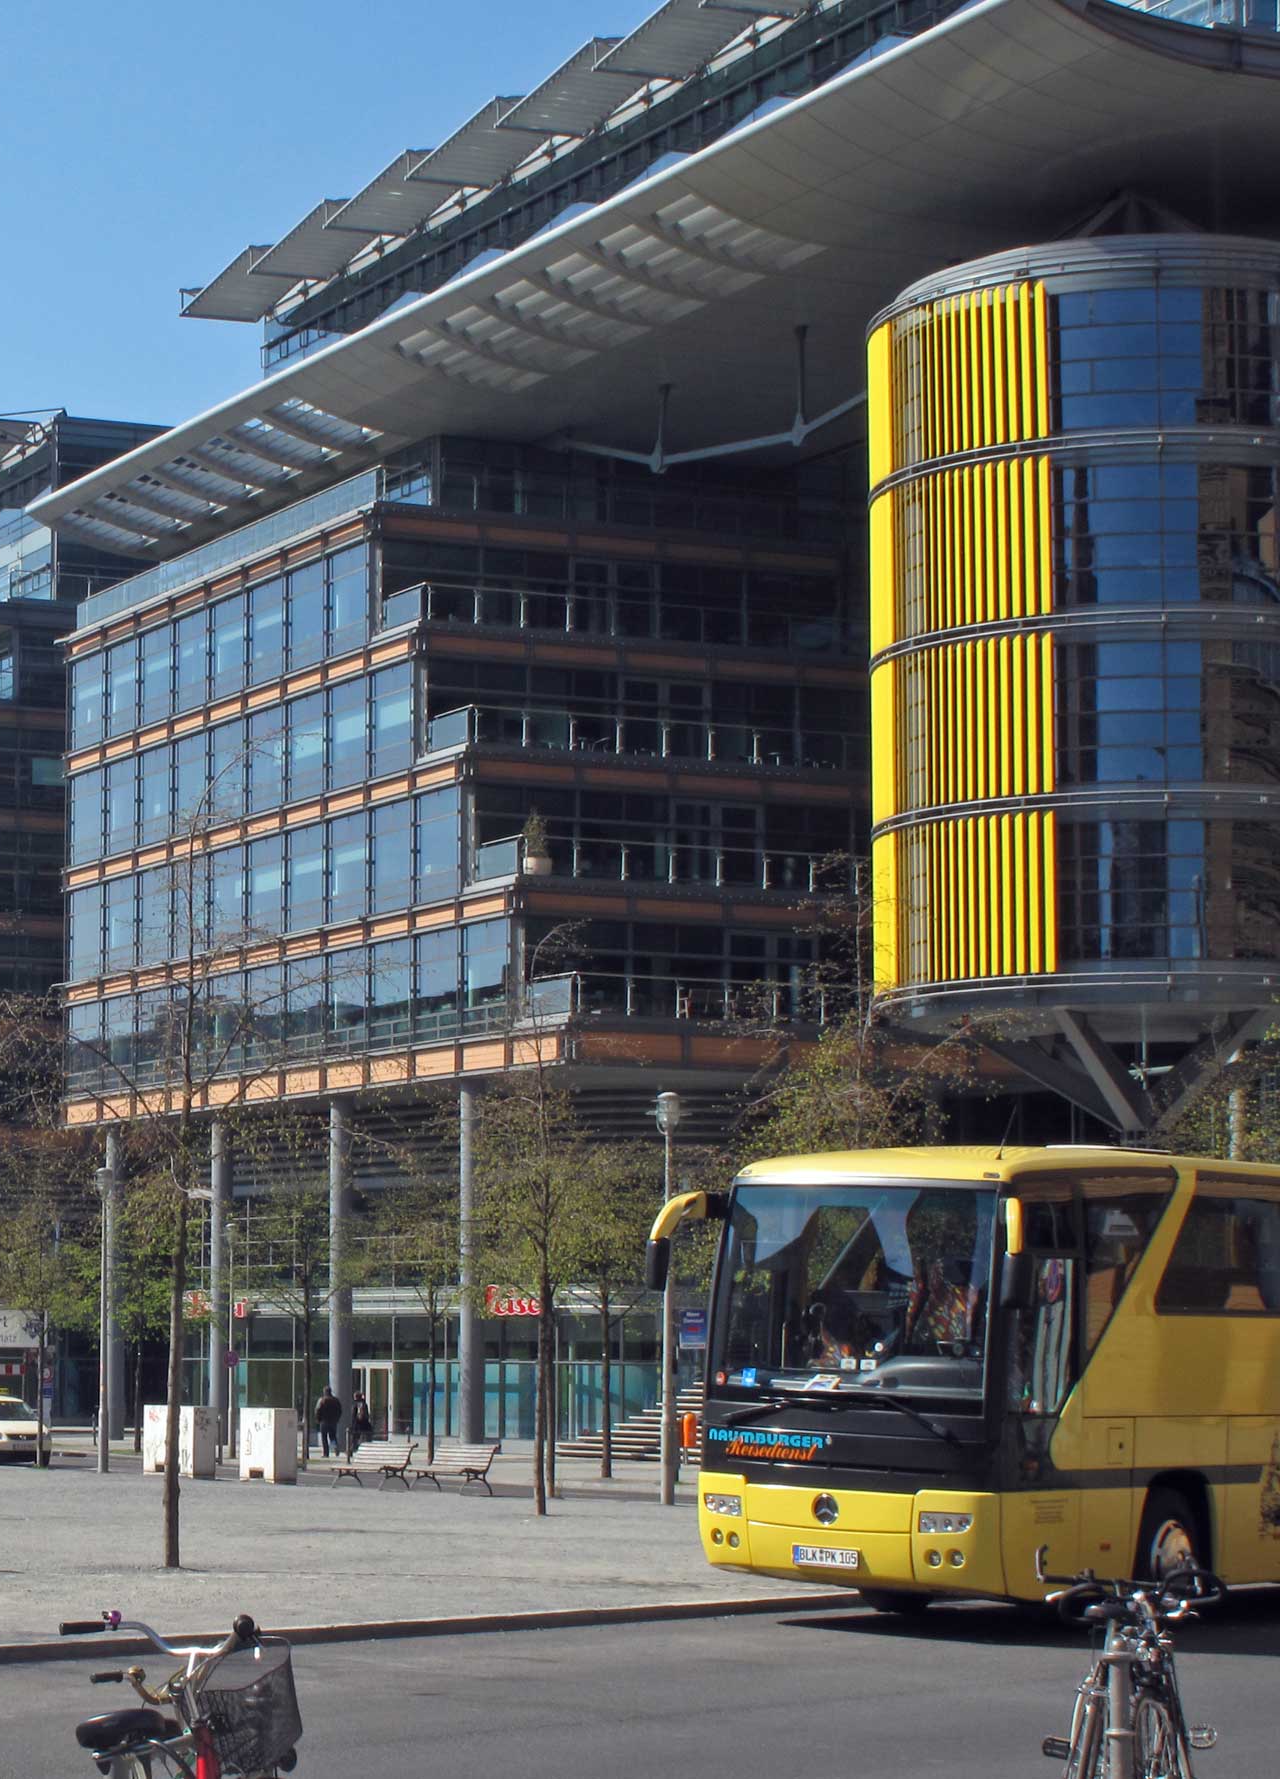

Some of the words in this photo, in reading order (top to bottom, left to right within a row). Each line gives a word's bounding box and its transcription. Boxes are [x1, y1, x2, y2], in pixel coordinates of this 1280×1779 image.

[708, 1428, 823, 1448] NAUMBURGER
[725, 1437, 817, 1460] Reisedienst
[799, 1548, 818, 1562] BLK
[824, 1550, 837, 1563] PK
[839, 1552, 857, 1565] 105
